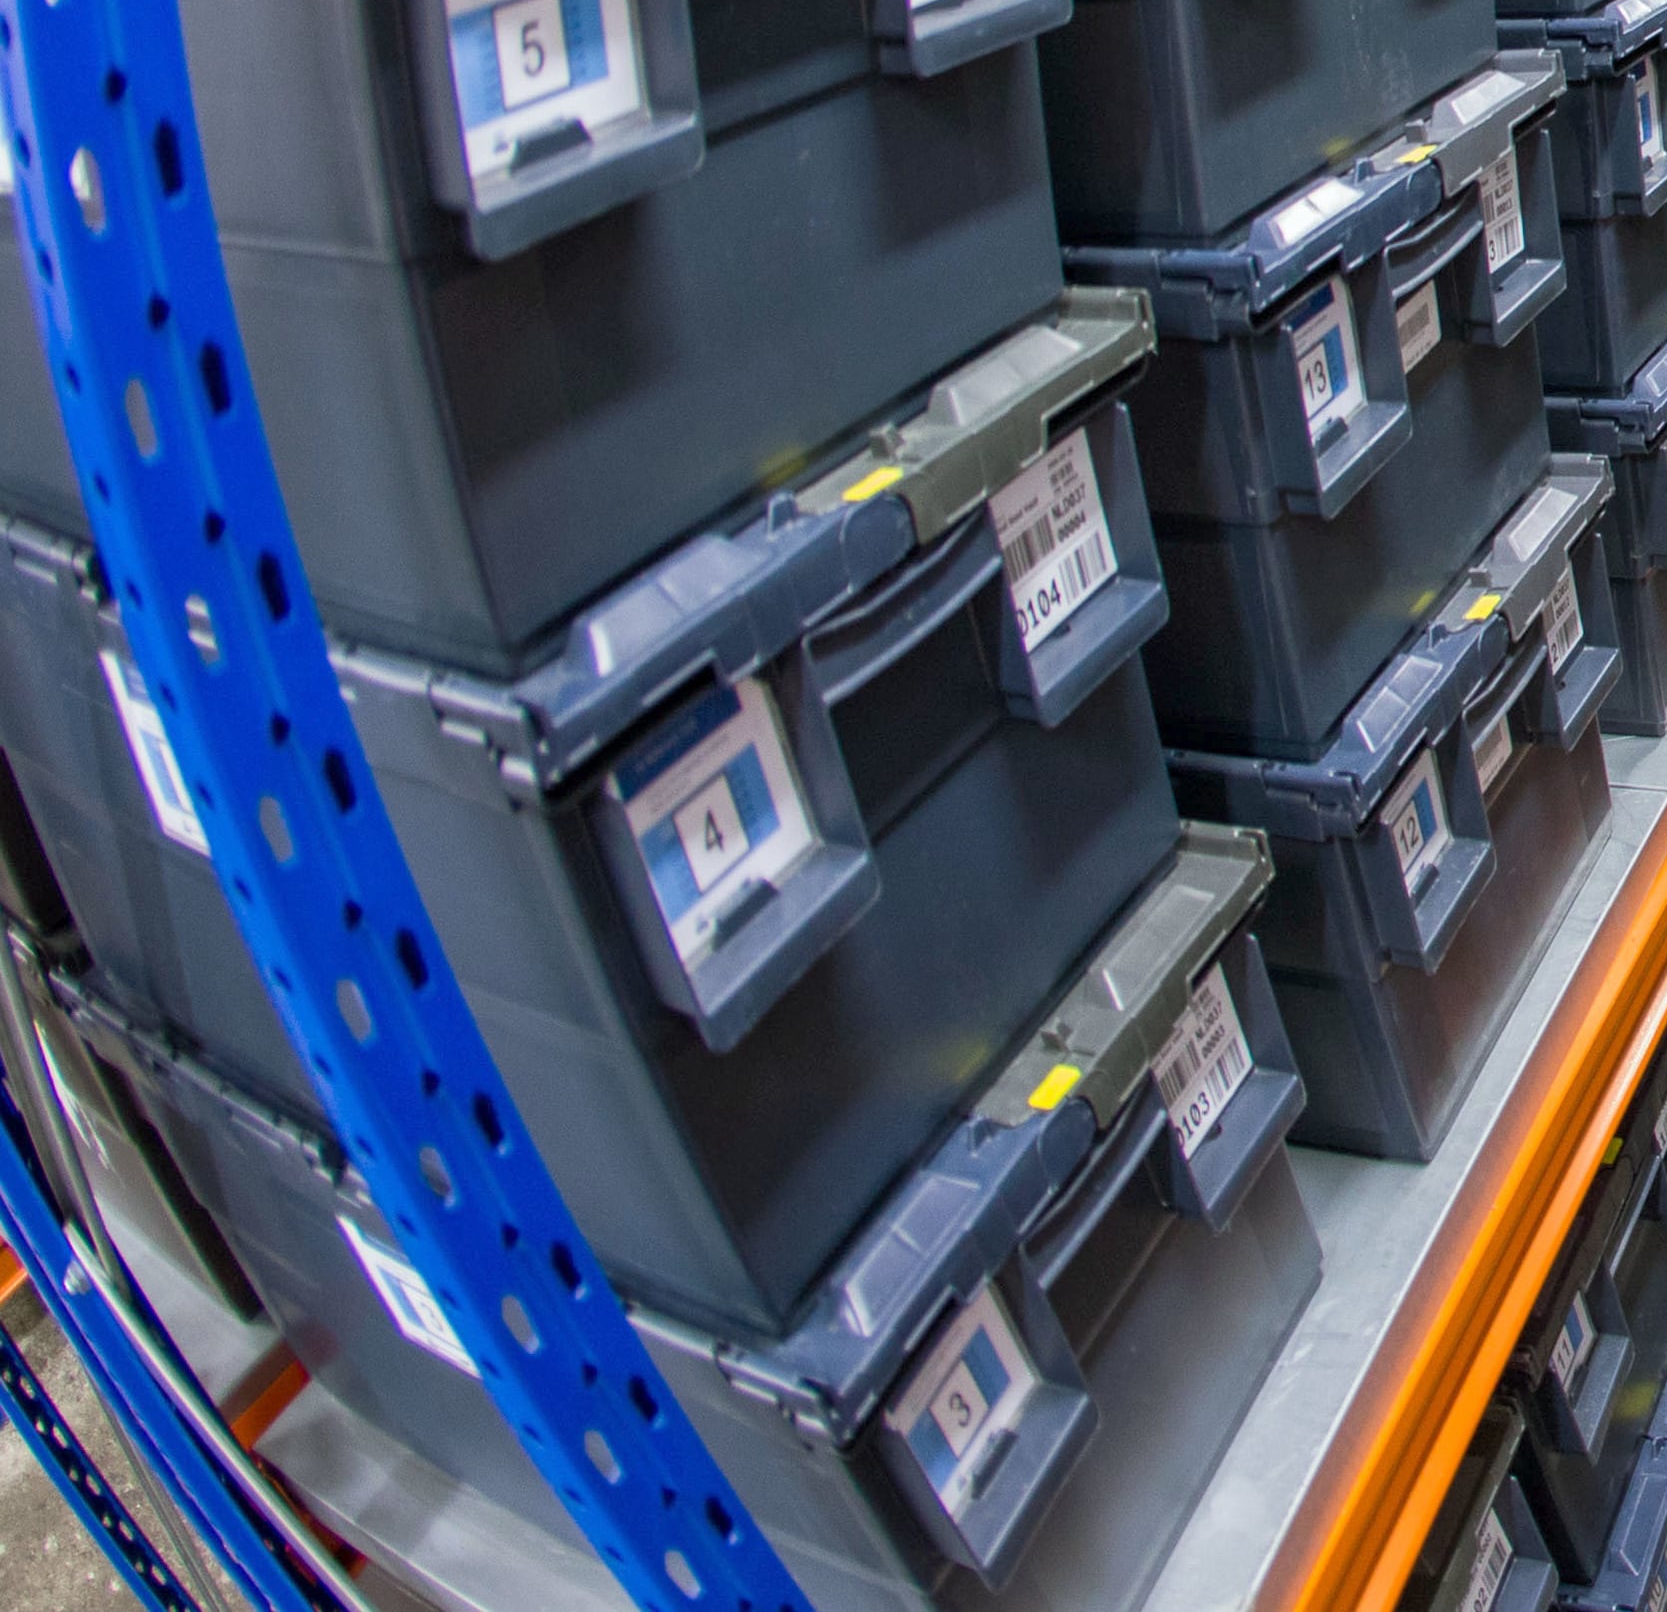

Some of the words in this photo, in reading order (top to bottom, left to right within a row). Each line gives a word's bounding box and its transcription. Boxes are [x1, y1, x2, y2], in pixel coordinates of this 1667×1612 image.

[520, 19, 546, 77] 5
[1304, 360, 1327, 401] 13
[705, 806, 724, 853] 4
[1399, 816, 1419, 856] 12
[1555, 1340, 1574, 1374] 11
[950, 1392, 970, 1427] 3
